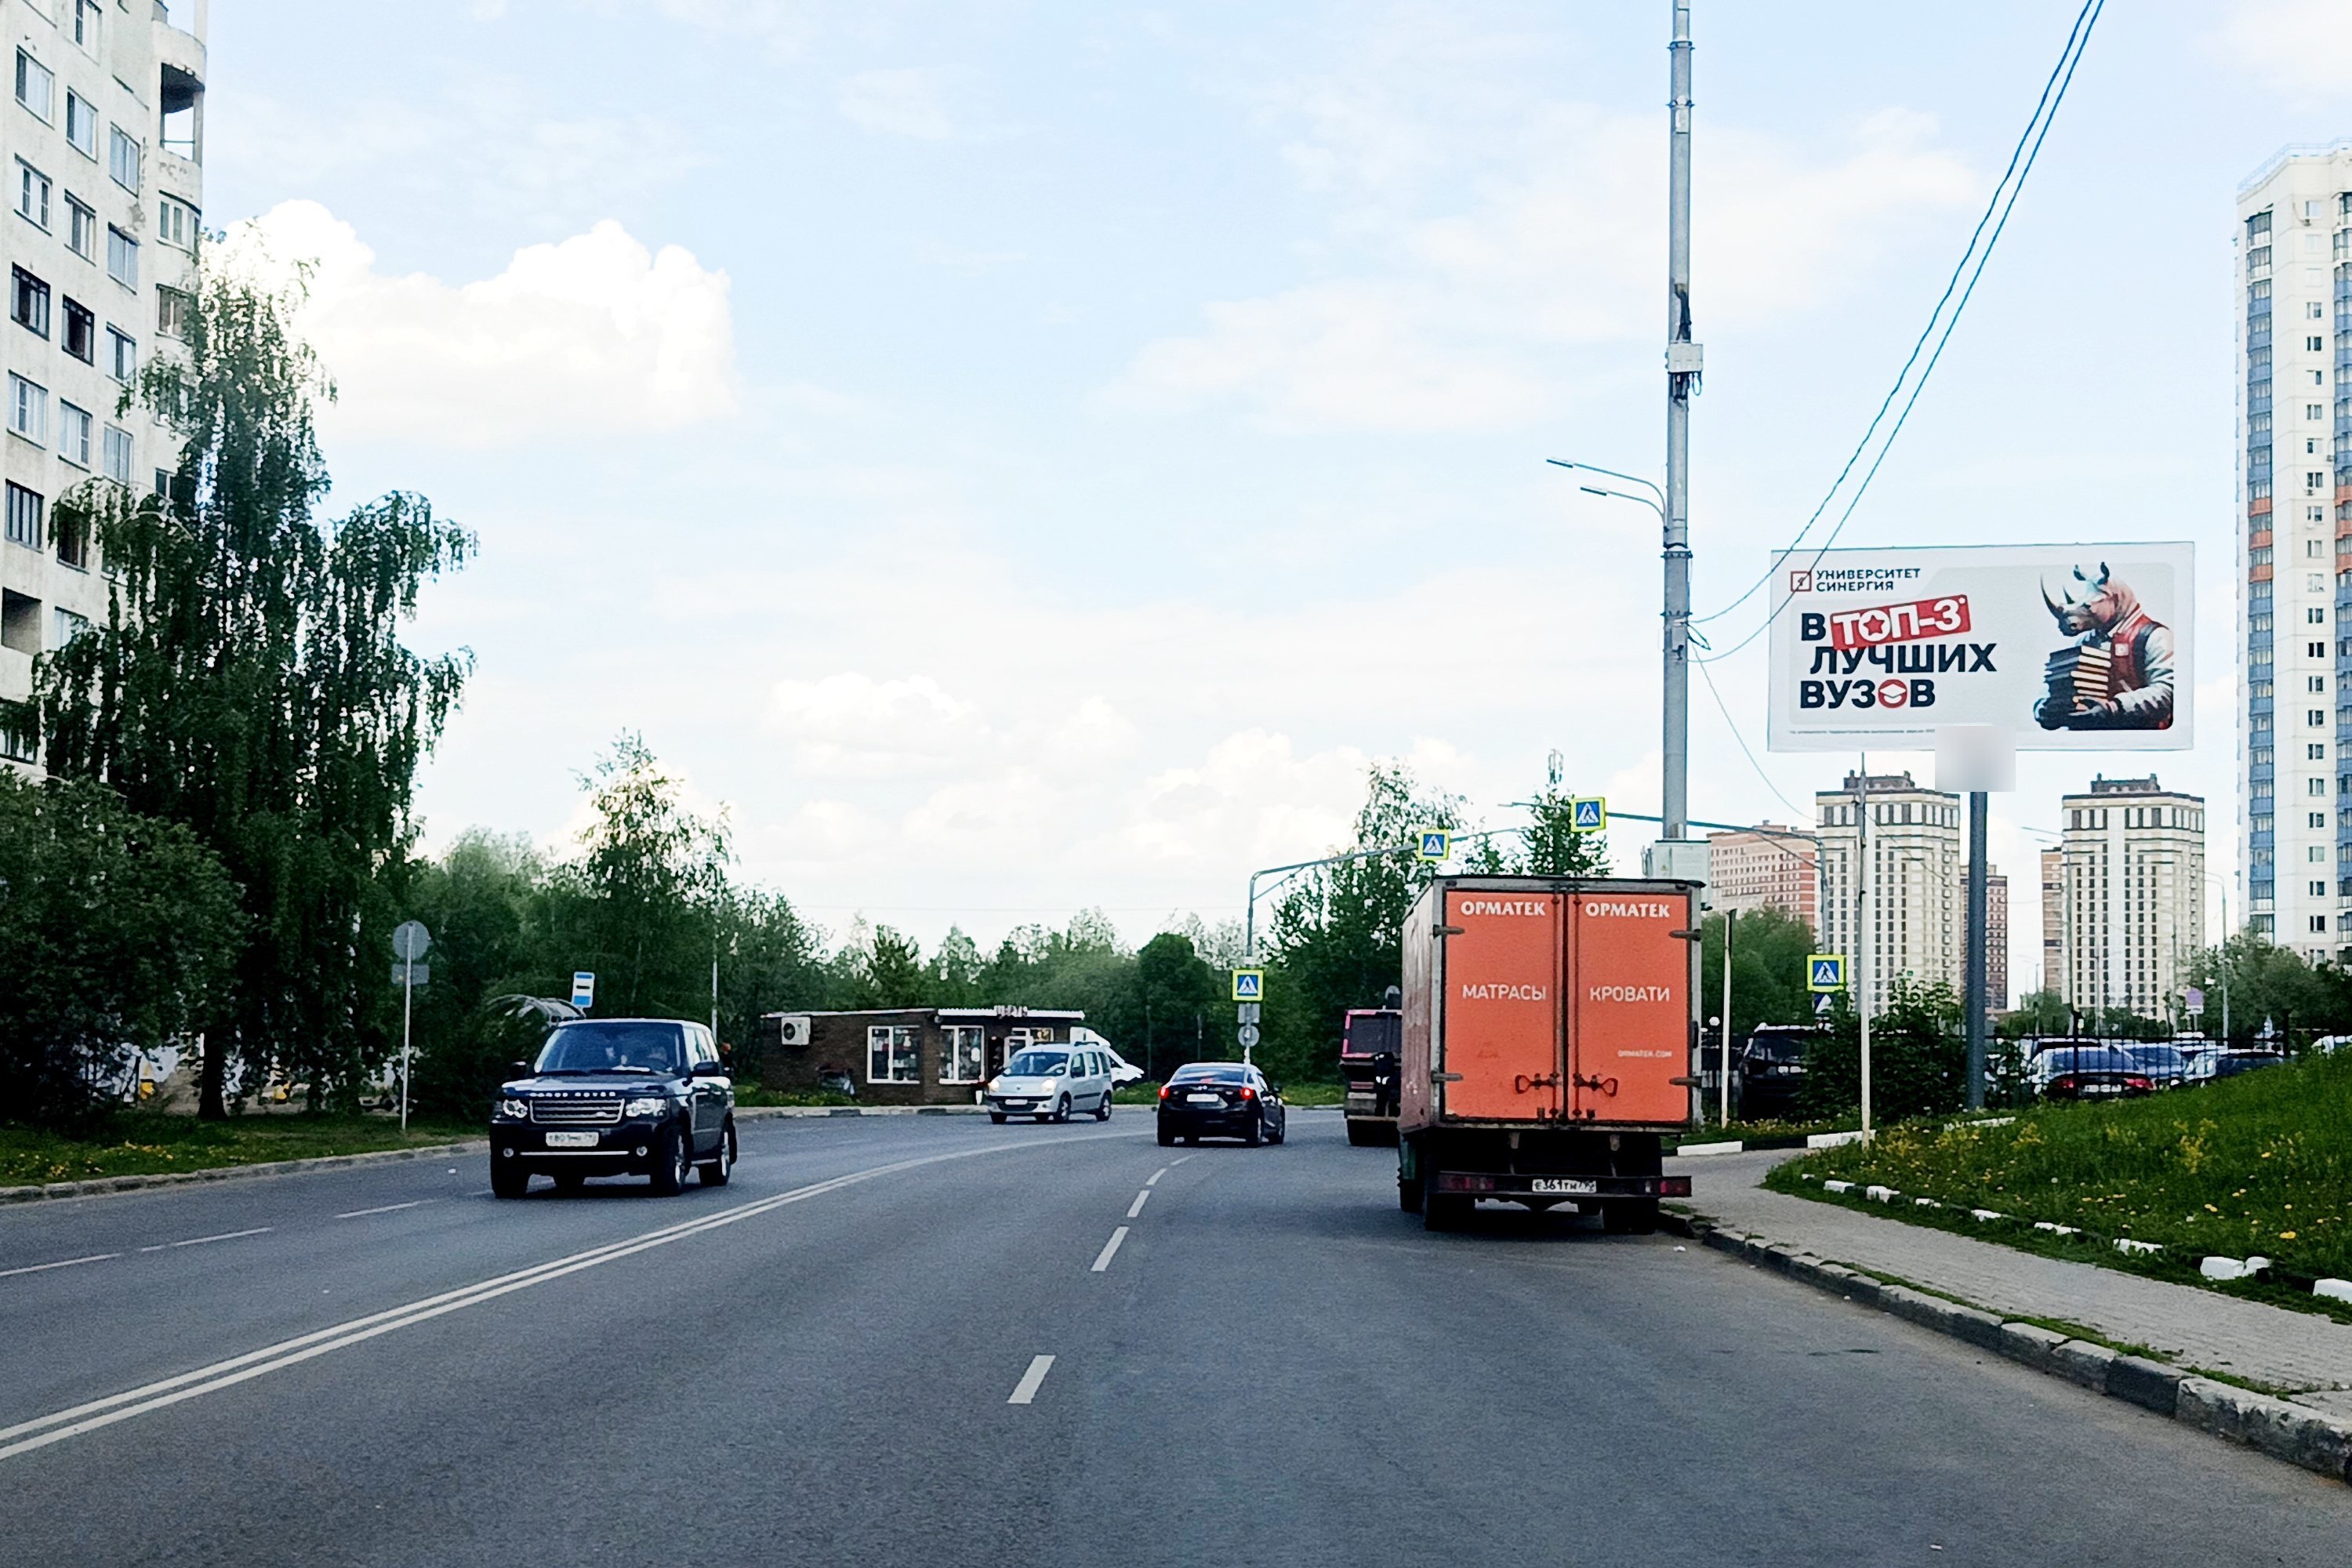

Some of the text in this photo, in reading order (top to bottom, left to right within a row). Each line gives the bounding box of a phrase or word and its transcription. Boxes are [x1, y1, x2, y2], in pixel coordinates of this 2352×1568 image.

[1817, 568, 1921, 580] УНИВЕРСИТЕТ
[1817, 581, 1893, 592] СИНЕРГИЯ
[1801, 613, 1826, 641] В
[1810, 643, 1998, 674] ЛУЧШИХ
[1801, 679, 1936, 708] ВУЗОВ
[1461, 901, 1545, 916] ОРМАТЕК
[1585, 902, 1670, 918] ОРМАТЕК
[1462, 984, 1547, 1000] МАТРАСЫ
[1590, 985, 1670, 1003] КРОВАТИ
